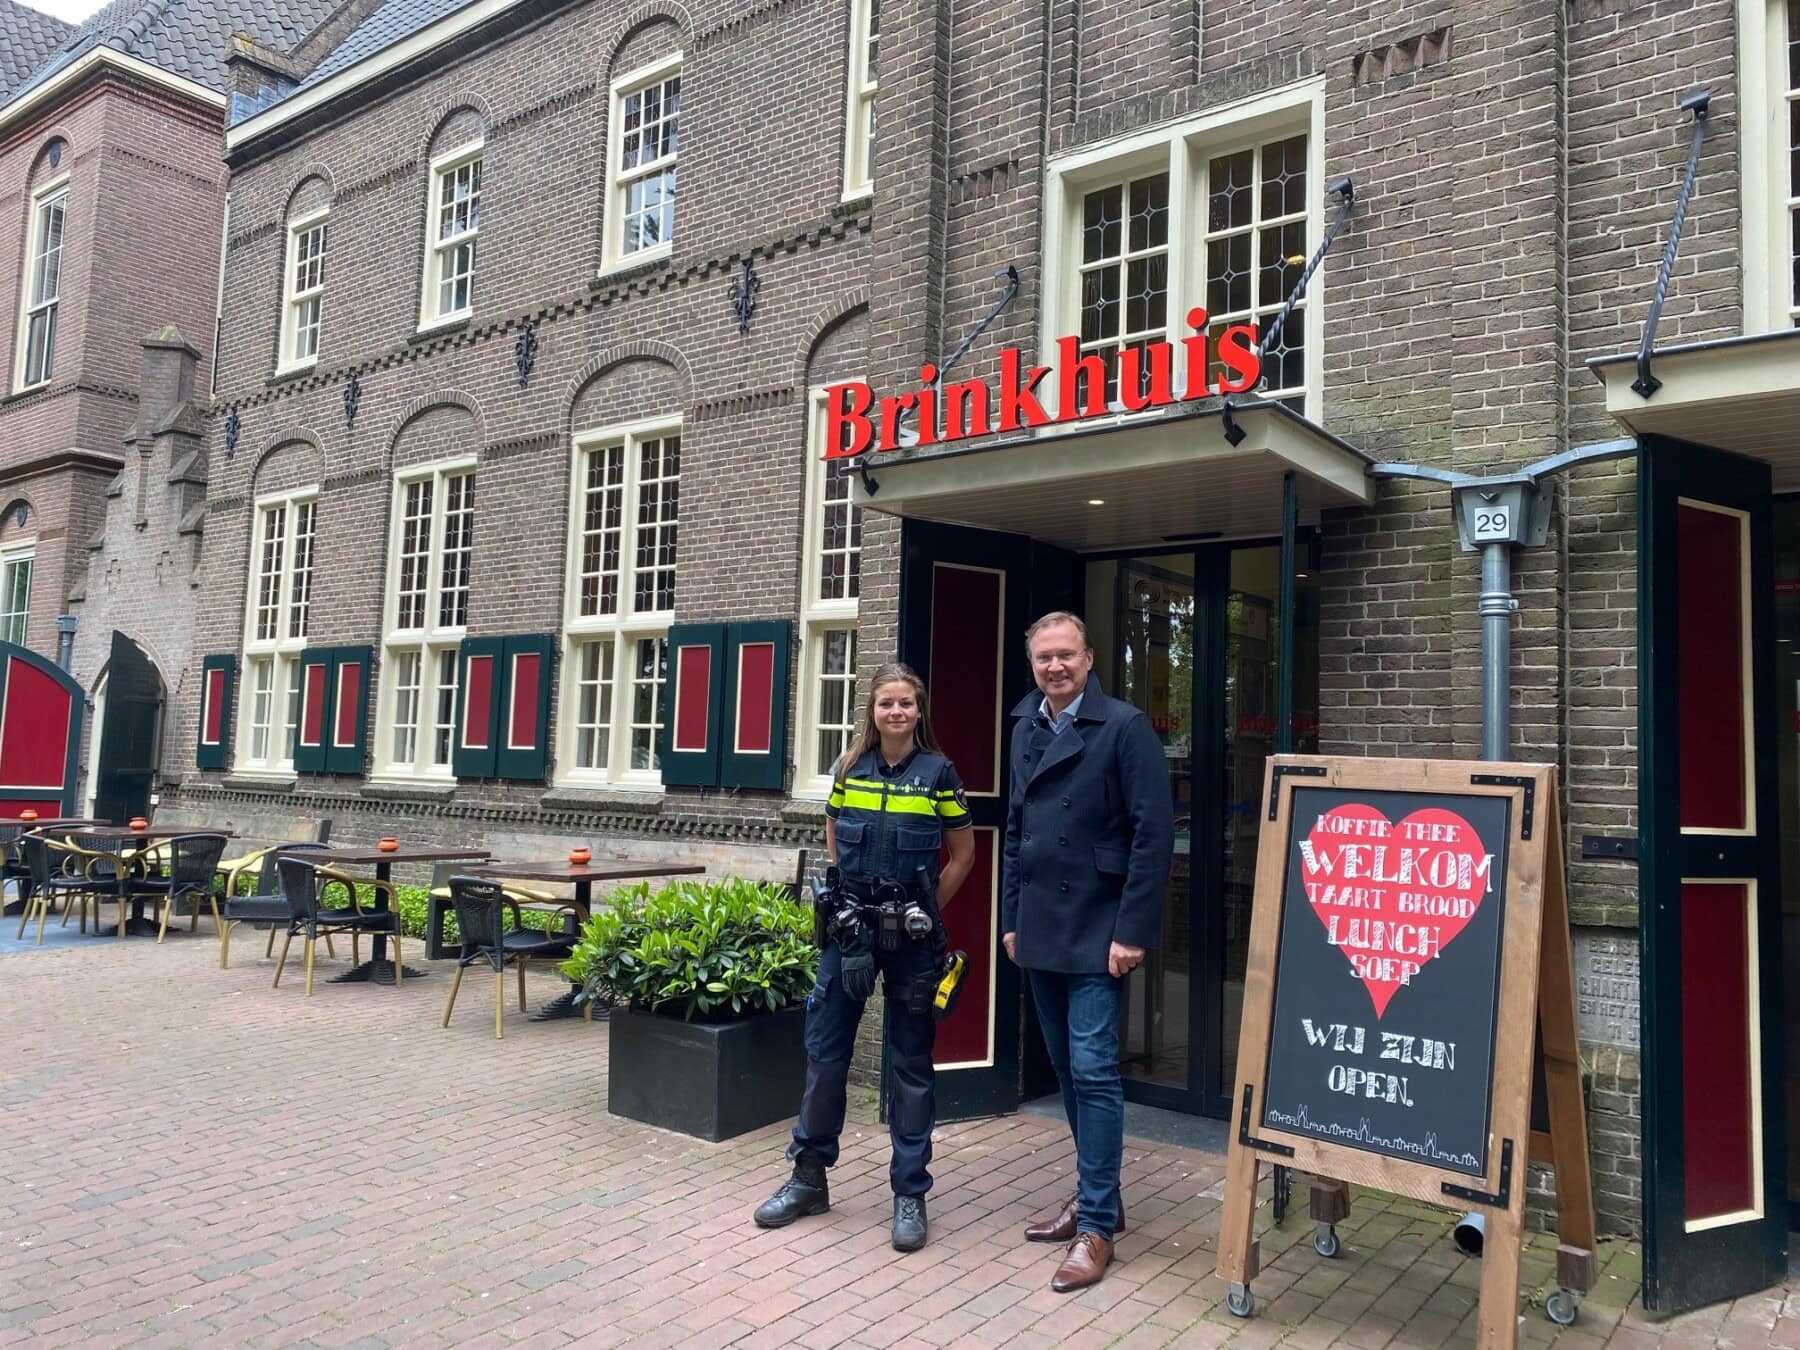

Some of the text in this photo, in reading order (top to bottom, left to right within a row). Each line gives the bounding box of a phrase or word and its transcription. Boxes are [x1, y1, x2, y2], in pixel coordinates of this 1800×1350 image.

[821, 306, 1262, 460] Brinkhuis
[1477, 513, 1507, 533] 29
[1316, 814, 1461, 843] KOFFIE THEE
[1298, 839, 1496, 893] WELKOM
[1305, 881, 1476, 919] TAART BROOD
[1328, 915, 1441, 959] LUNCH
[1350, 954, 1421, 986] SOEP
[1302, 1018, 1456, 1070] WIJ ZIJN
[1328, 1065, 1414, 1107] OPEN.
